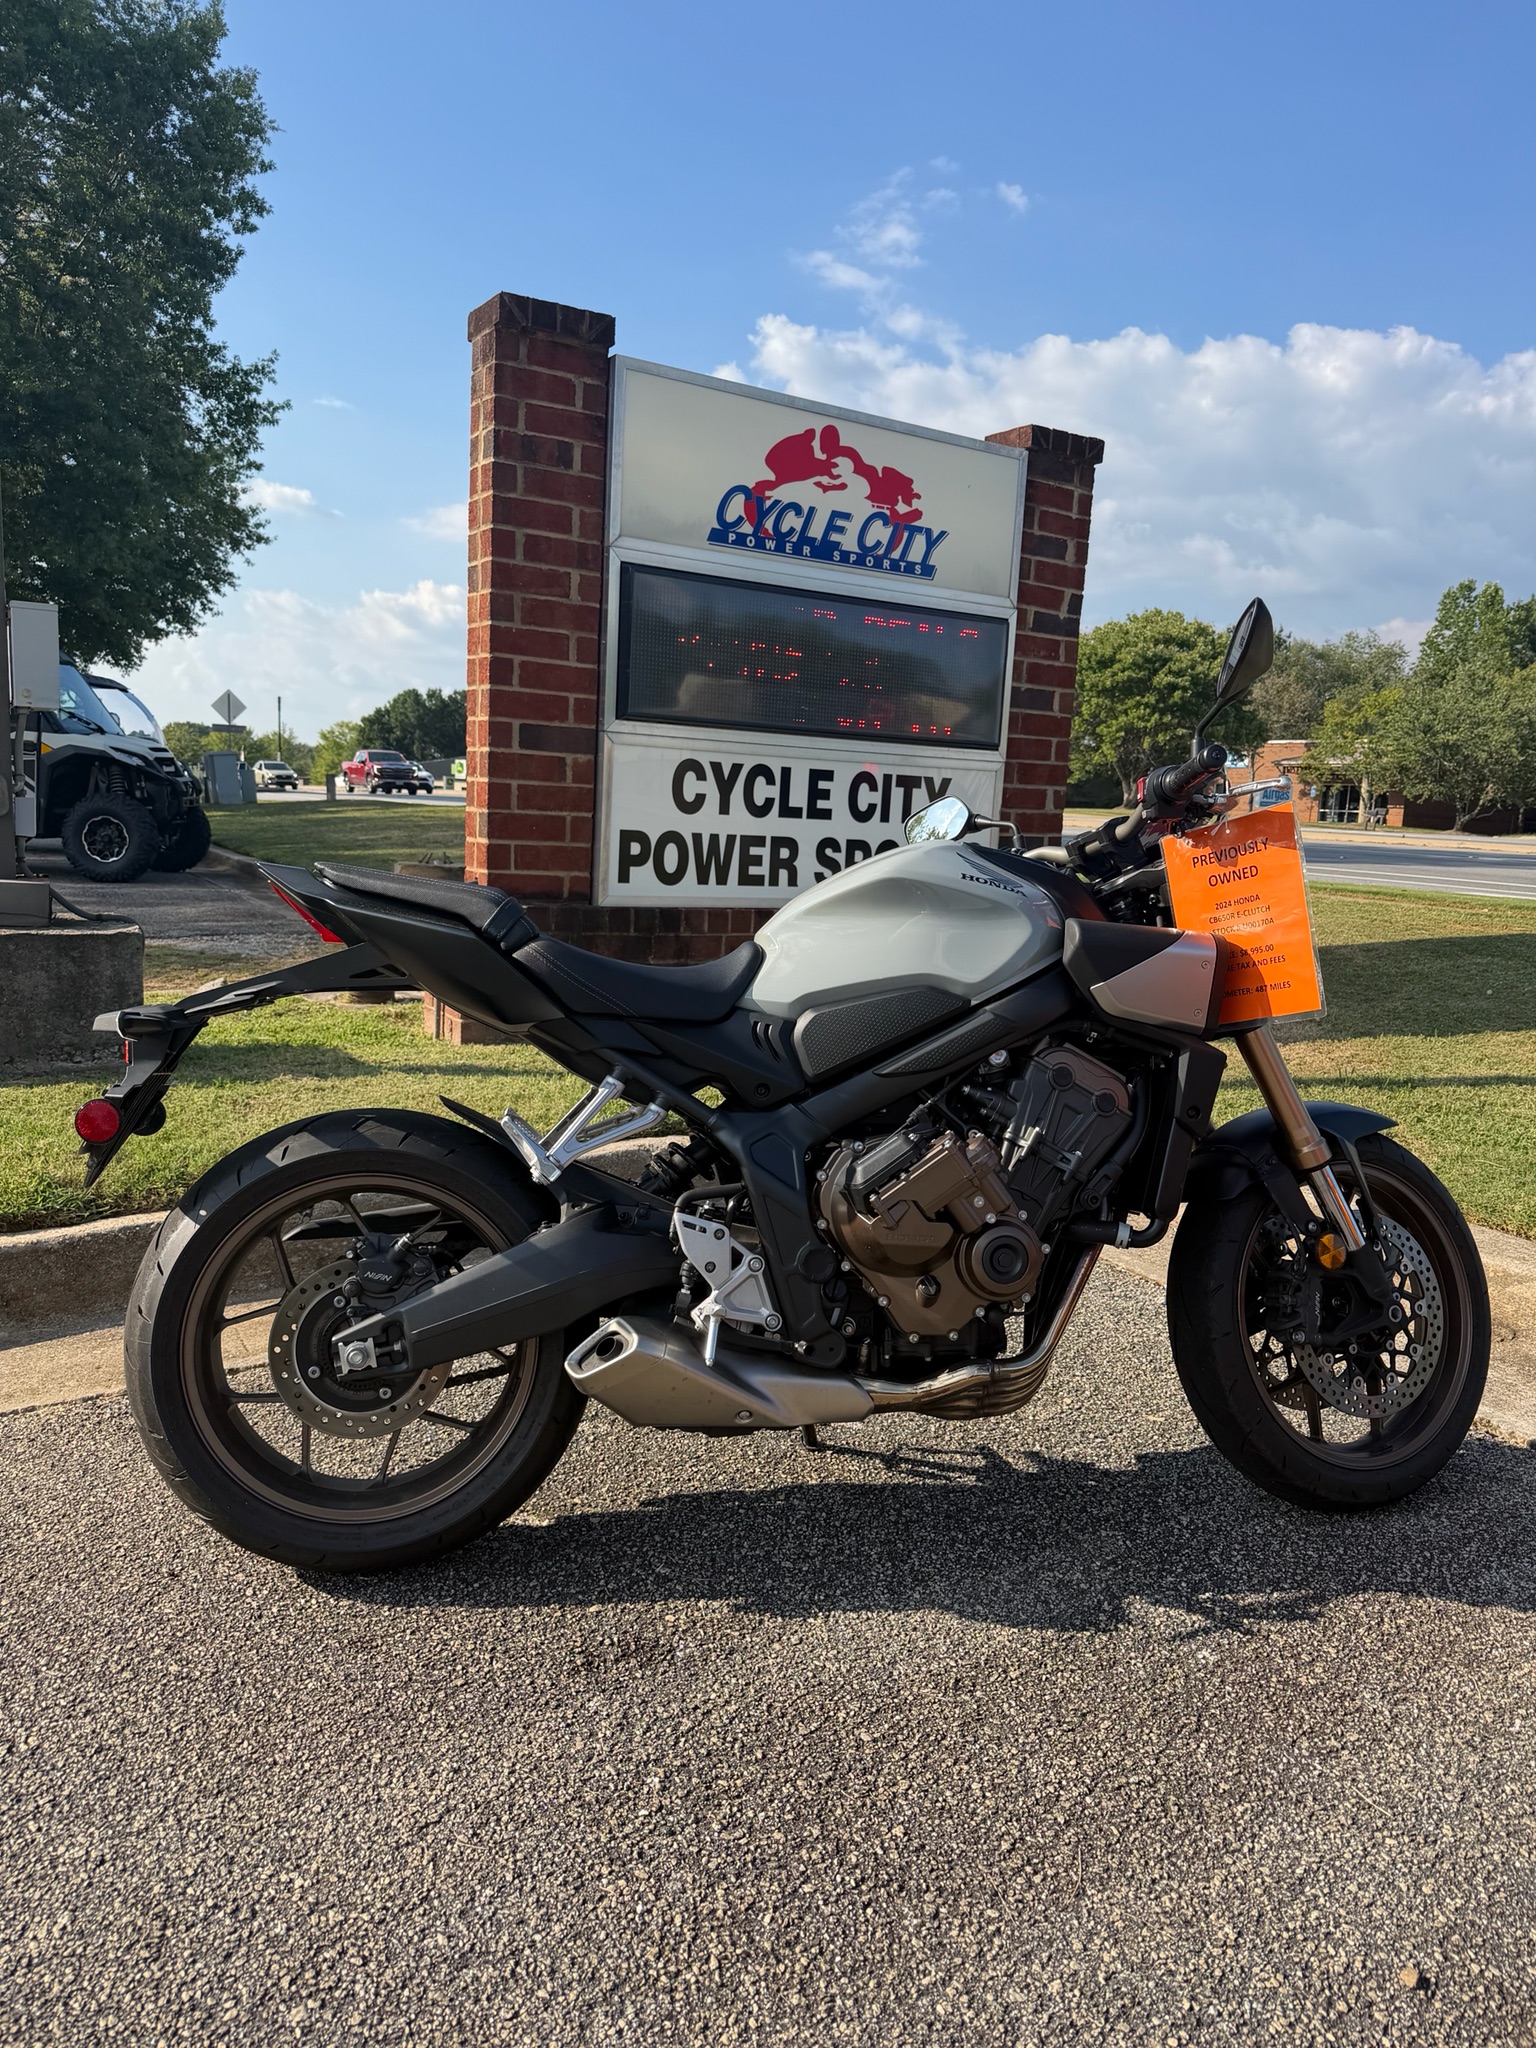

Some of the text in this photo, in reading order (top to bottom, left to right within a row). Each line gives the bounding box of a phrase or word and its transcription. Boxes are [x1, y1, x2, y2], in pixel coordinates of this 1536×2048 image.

[716, 484, 950, 565] CYCLE CITY
[728, 533, 922, 575] POWER SPORTS
[672, 758, 835, 820] CYCLE
[1262, 788, 1290, 801] Airgas
[617, 829, 799, 888] POWER
[1192, 838, 1268, 868] PREVIOUSLY
[960, 873, 1028, 898] HONDA
[1208, 865, 1259, 887] OWNED
[1215, 894, 1260, 910] 2024 HONDA
[1209, 905, 1271, 924] CB650R E-CLUTCH
[1213, 924, 1236, 936] STOCK
[1243, 917, 1275, 930] U00170A
[1240, 944, 1275, 958] $8,995.00
[1236, 961, 1250, 971] TAX
[1252, 958, 1268, 969] AND
[1270, 954, 1286, 965] FEES
[1255, 984, 1268, 993] 487
[1269, 981, 1291, 991] MILES
